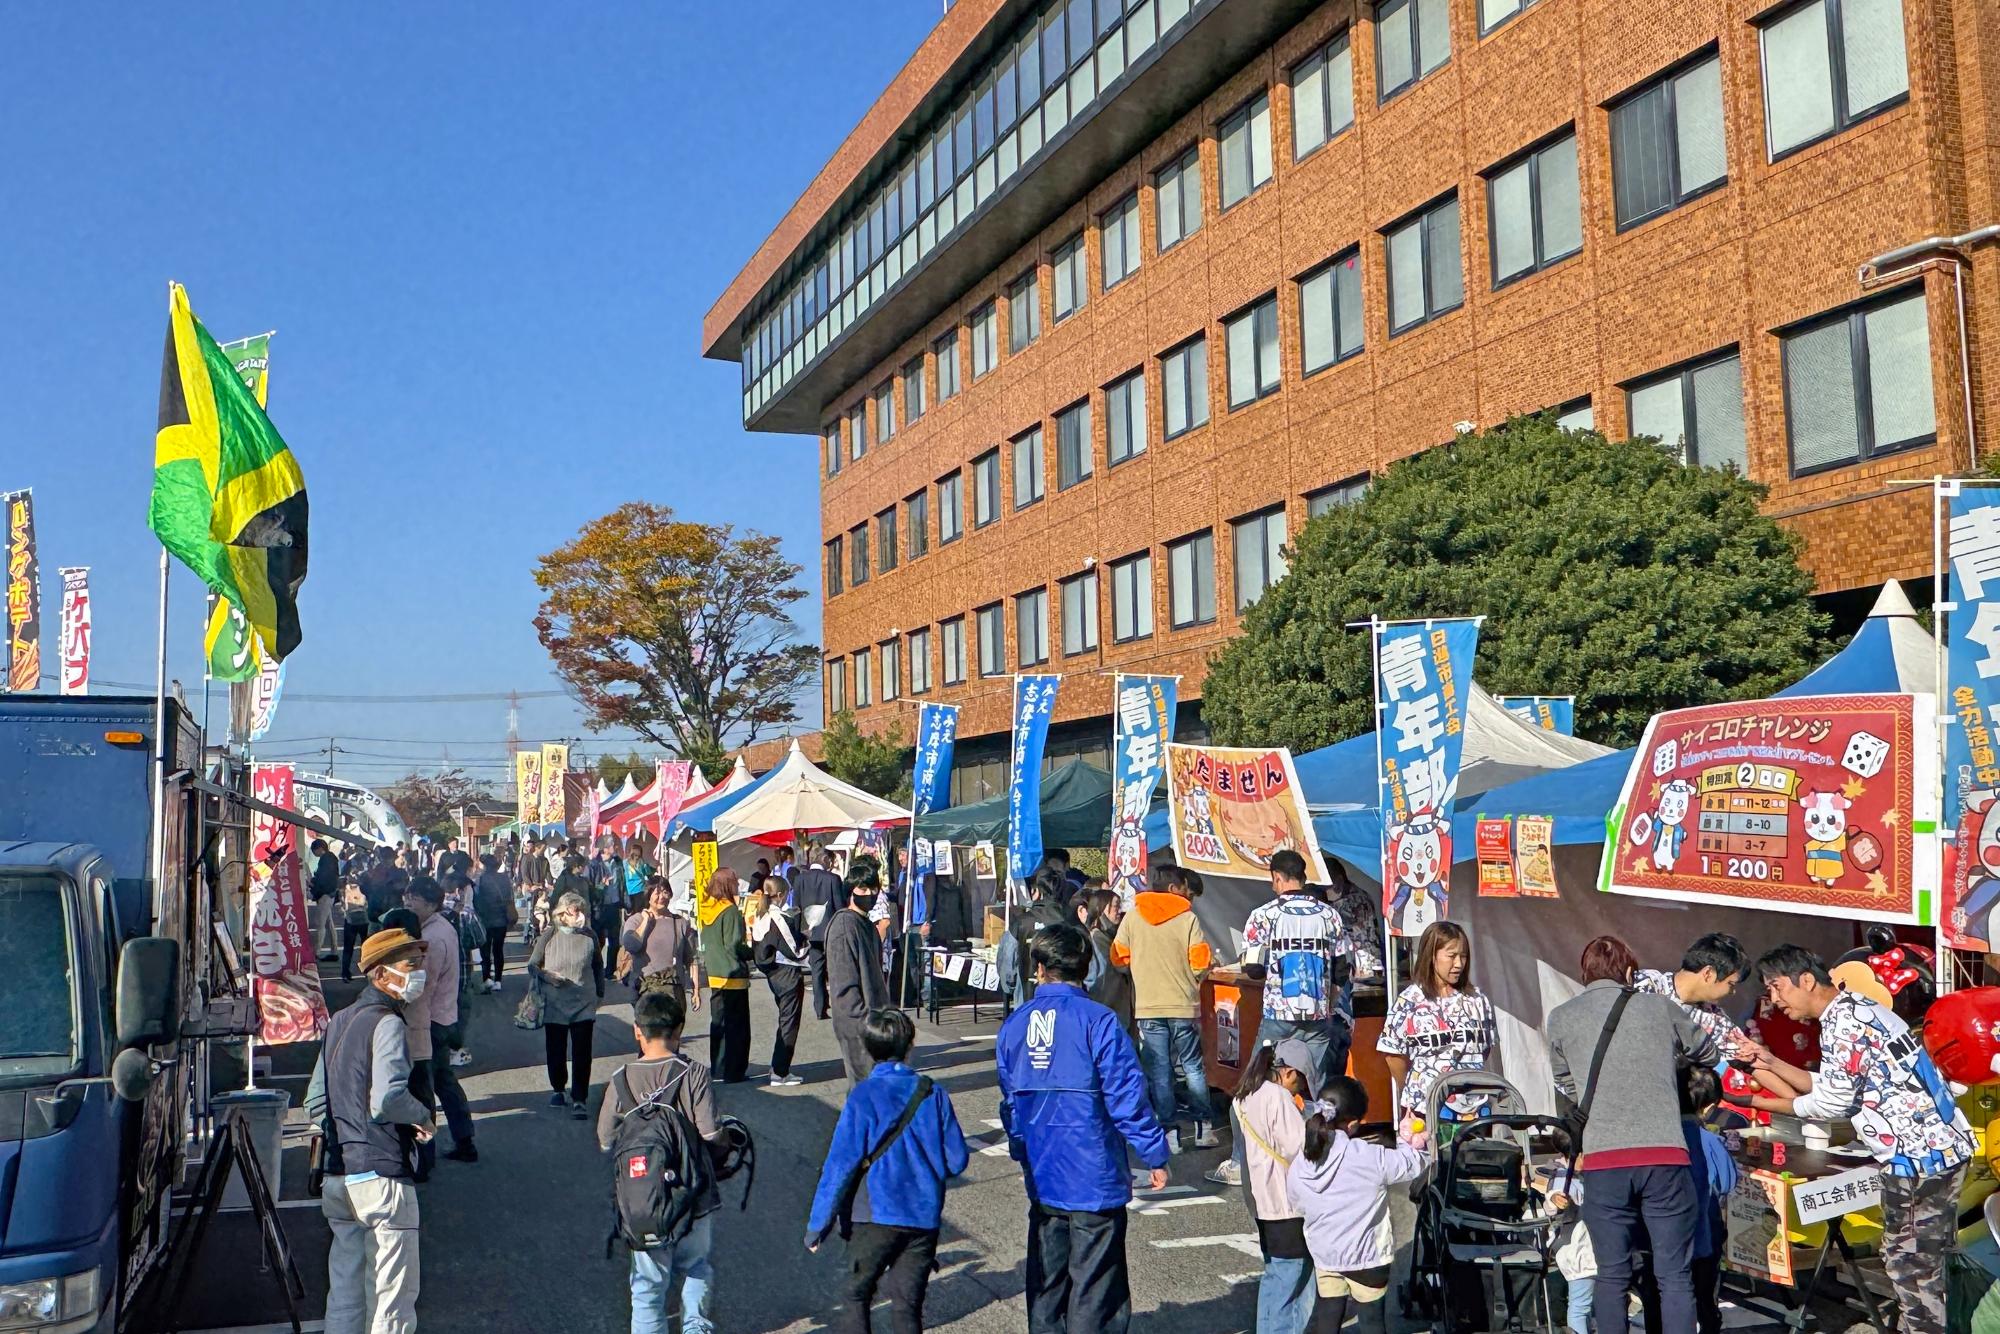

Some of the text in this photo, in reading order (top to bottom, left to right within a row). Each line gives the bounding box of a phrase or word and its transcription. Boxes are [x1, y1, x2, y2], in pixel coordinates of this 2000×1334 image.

[10, 501, 33, 662] ロングポテト
[66, 591, 91, 689] ケバブ
[1036, 683, 1055, 714] みえ
[941, 714, 955, 744] みえ
[1380, 633, 1447, 816] 青年部
[1680, 715, 1833, 750] サイコロチャレンジ
[1119, 685, 1160, 822] 青年部
[1197, 757, 1282, 794] たません
[1742, 766, 1751, 784] 2
